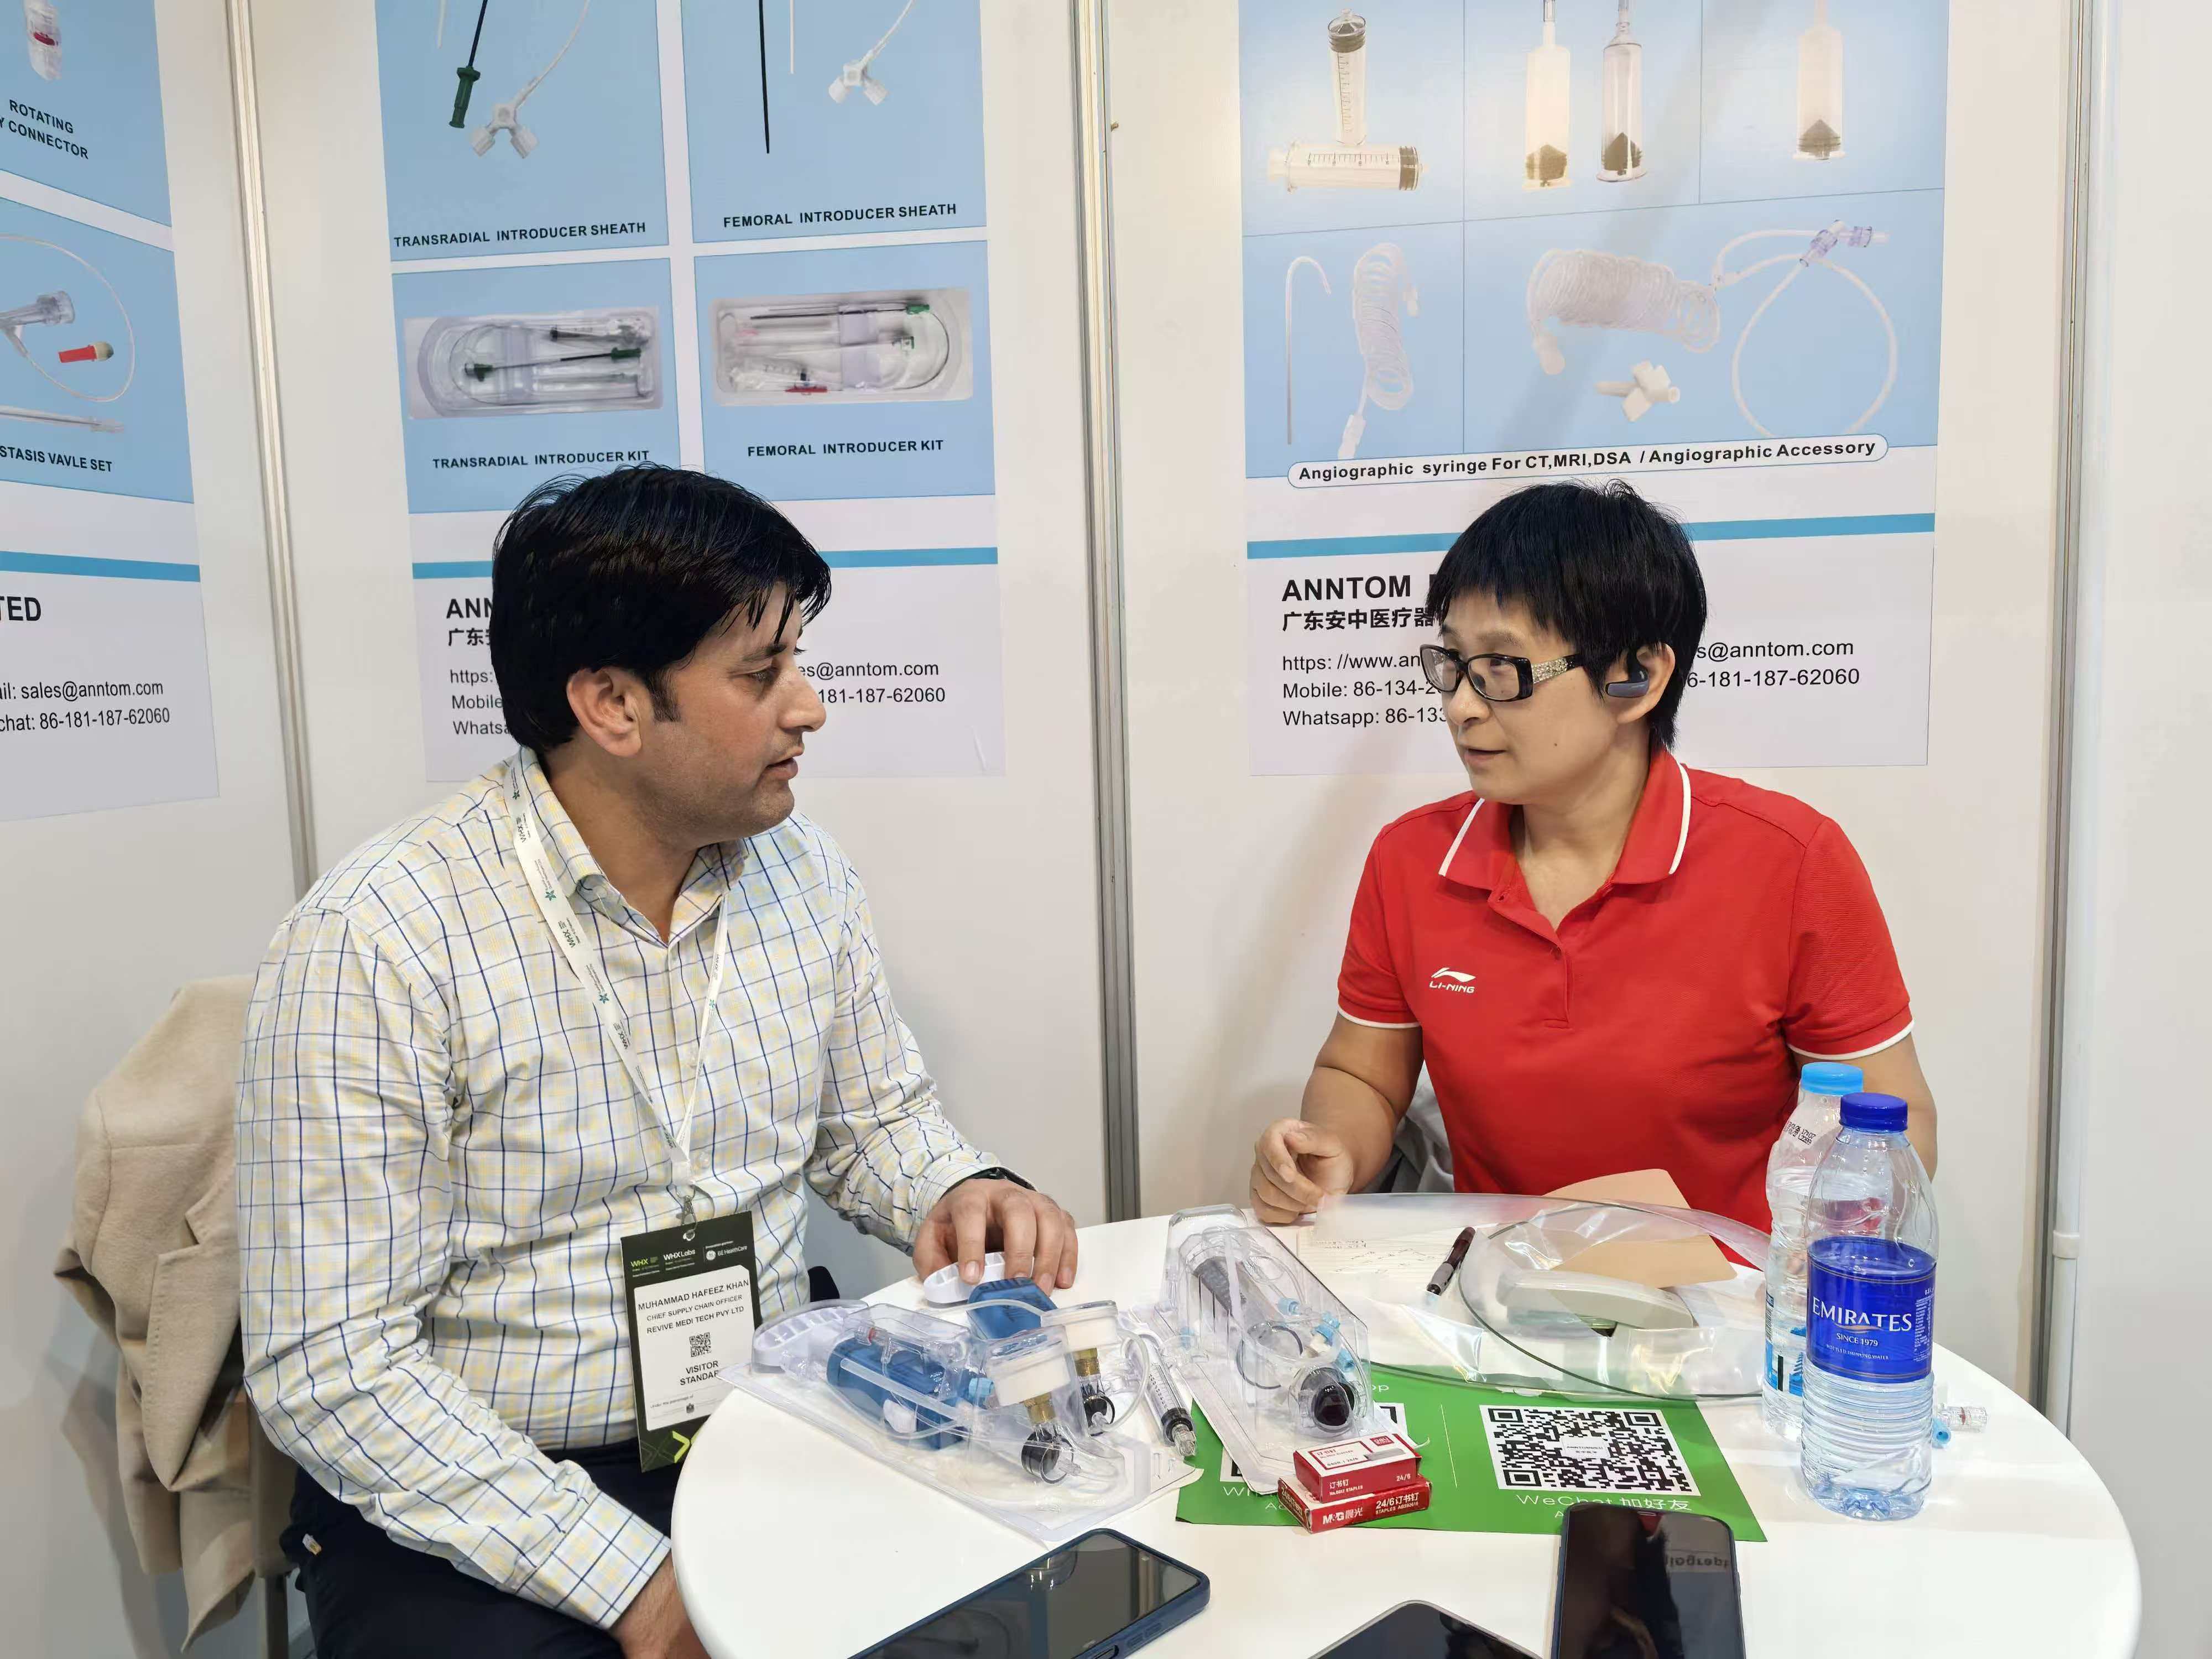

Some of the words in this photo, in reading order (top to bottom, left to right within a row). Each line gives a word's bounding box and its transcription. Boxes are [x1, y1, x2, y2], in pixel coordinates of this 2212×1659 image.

[9, 99, 74, 134] ROTATING
[9, 120, 88, 159] CONNECTOR
[723, 213, 792, 227] FEMORAL
[800, 207, 895, 223] INTRODUCER
[899, 204, 957, 217] SHEATH
[394, 231, 491, 247] TRANSRADIAL
[497, 225, 587, 241] INTRODUCER
[591, 222, 646, 236] SHEATH
[748, 445, 816, 456] FEMORAL
[823, 441, 917, 454] INTRODUCER
[921, 440, 943, 451] KIT
[48, 452, 87, 469] VAVLE
[91, 459, 112, 472] SET
[432, 456, 528, 468] TRANSRADIAL
[535, 451, 624, 465] INTRODUCER
[628, 451, 649, 461] KIT
[1298, 462, 1414, 482] Angiographic
[1423, 460, 1487, 476] syringe
[1493, 457, 1521, 471] For
[1525, 451, 1631, 469] CT,MRI,DSA
[1649, 444, 1770, 465] Angiographic
[1776, 443, 1875, 458] Accessory
[1281, 575, 1411, 602] ANNTOM
[1282, 656, 1331, 674] https:
[450, 669, 493, 686] https:
[21, 681, 163, 701] sales@anntom.com
[1283, 682, 1347, 698] Mobile:
[40, 707, 170, 729] 86-181-187-62060
[1282, 710, 1379, 728] Whatsapp:
[1429, 981, 1475, 993] LI-NING
[630, 1259, 649, 1267] WHX
[638, 1293, 690, 1311] MUHAMMAD
[692, 1286, 724, 1298] HAFEEZ
[726, 1279, 749, 1291] KHAN
[646, 1312, 666, 1321] CHIEF
[668, 1306, 693, 1317] SUPPLY
[695, 1301, 714, 1311] CHAIN
[716, 1295, 743, 1306] OFFICER
[1813, 1296, 1912, 1332] EMIRATES
[646, 1322, 674, 1334] REVIVE
[676, 1318, 693, 1328] MEDI
[695, 1313, 714, 1323] TECH
[732, 1306, 744, 1314] LTD
[1837, 1333, 1859, 1344] SINCE
[1861, 1338, 1878, 1347] 1979
[686, 1360, 719, 1374] VISITOR
[1329, 1479, 1349, 1489] 订书钉
[1396, 1473, 1411, 1481] 24/6
